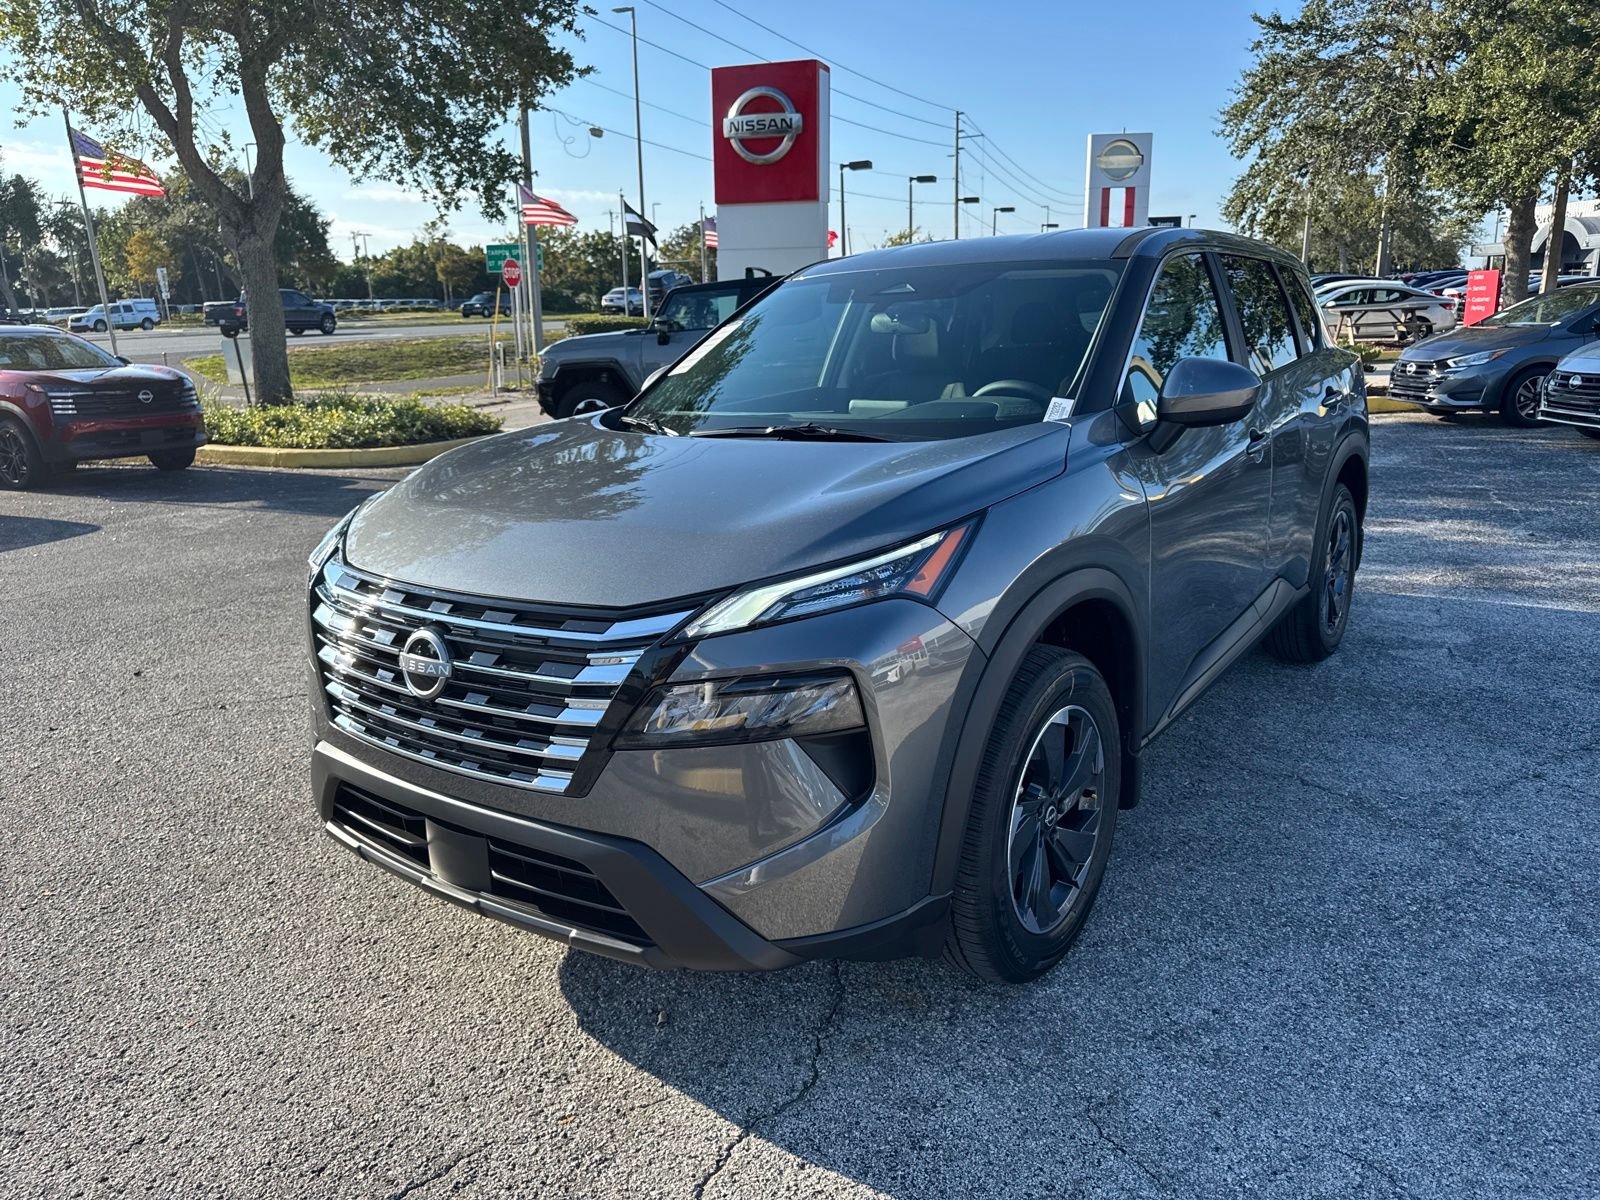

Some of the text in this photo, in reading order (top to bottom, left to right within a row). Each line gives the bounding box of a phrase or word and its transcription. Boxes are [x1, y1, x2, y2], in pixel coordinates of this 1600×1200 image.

[729, 118, 793, 133] NISSAN
[504, 267, 520, 279] STOP
[399, 654, 450, 676] NISSAN
